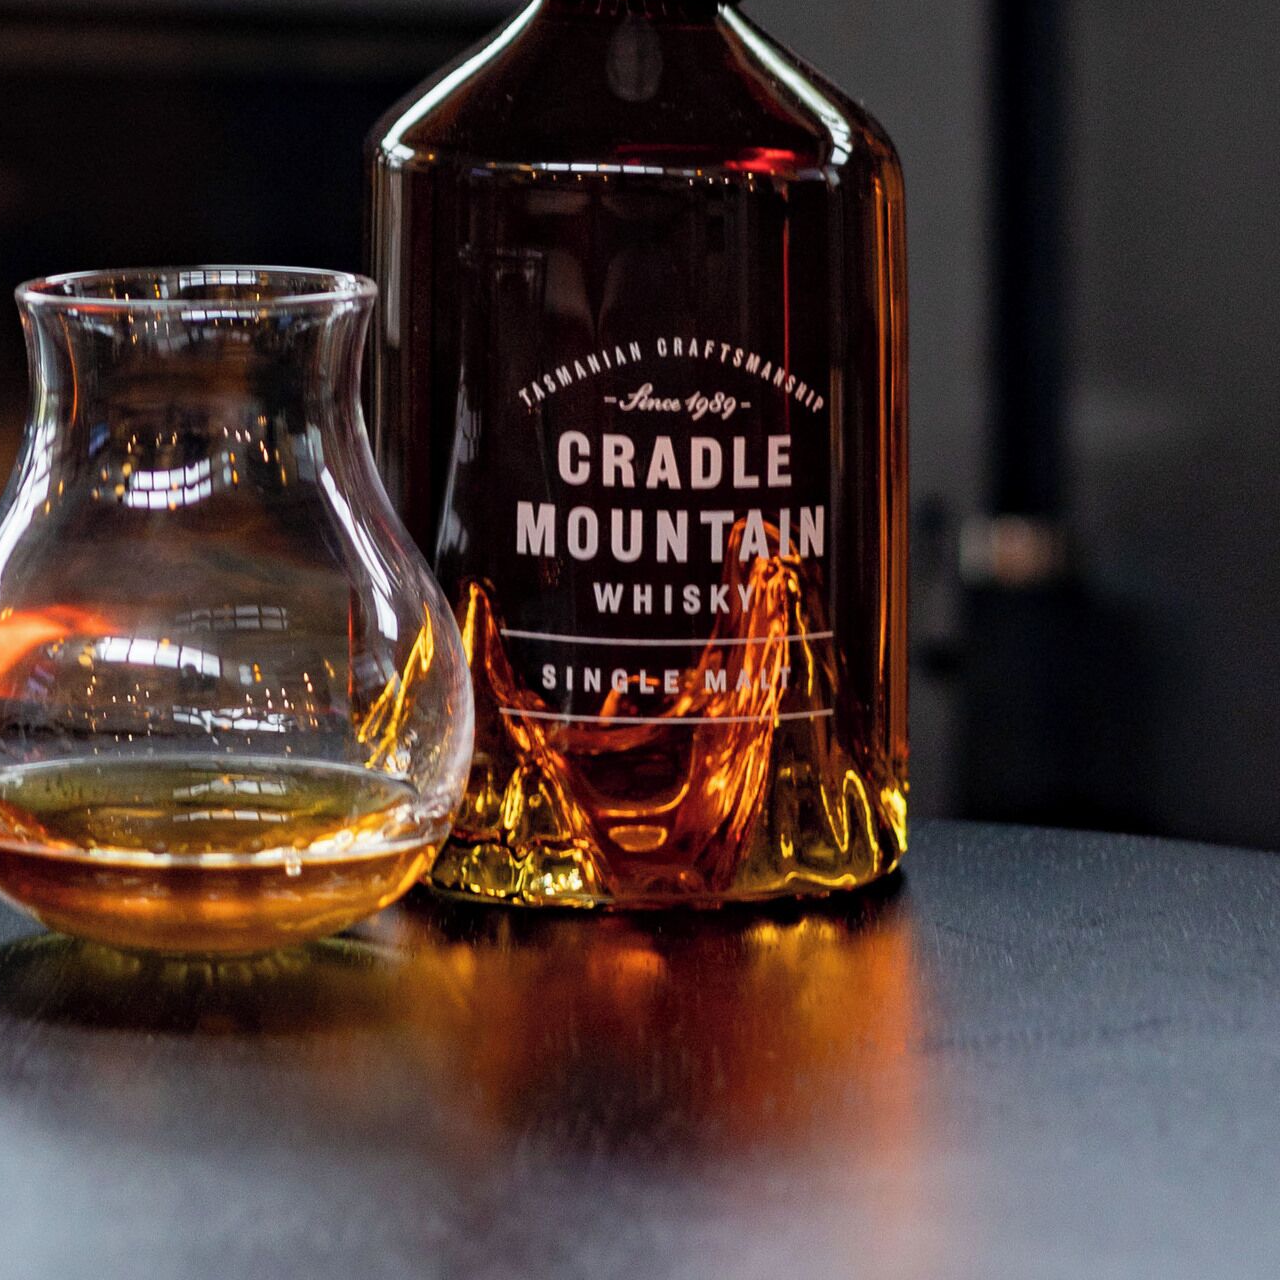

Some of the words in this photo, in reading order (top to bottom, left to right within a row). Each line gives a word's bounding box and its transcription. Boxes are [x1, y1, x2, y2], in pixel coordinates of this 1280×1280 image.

[518, 341, 642, 407] TASMANIAN
[657, 337, 825, 413] CRAFTSMANSHIP
[618, 382, 682, 412] Since
[684, 390, 737, 422] 1989
[557, 429, 792, 490] CRADLE
[516, 500, 825, 564] MOUNTAIN
[593, 581, 755, 615] WHISKY
[541, 663, 680, 695] SINGLE
[704, 666, 792, 692] MALT
